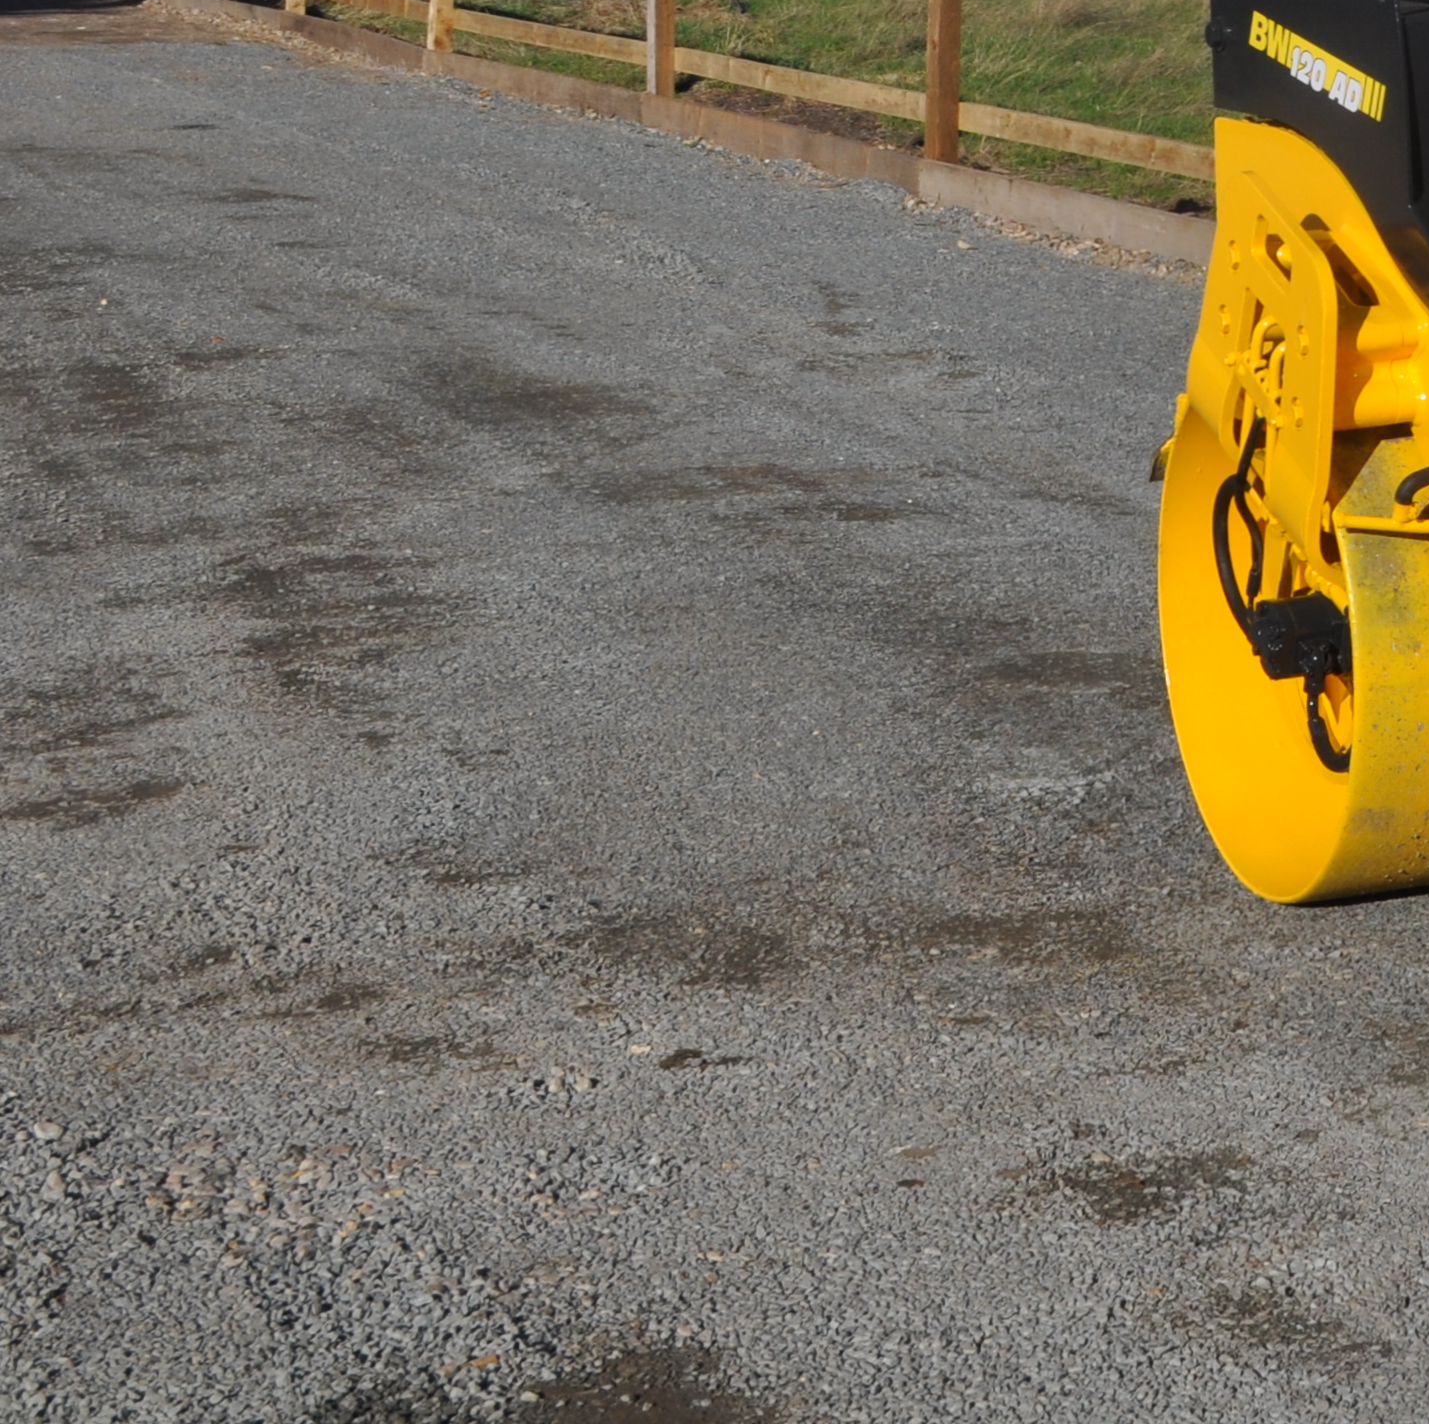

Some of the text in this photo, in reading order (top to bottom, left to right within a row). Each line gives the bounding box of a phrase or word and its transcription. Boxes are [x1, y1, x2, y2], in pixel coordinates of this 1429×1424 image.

[1249, 10, 1362, 113] BW 120 AD
